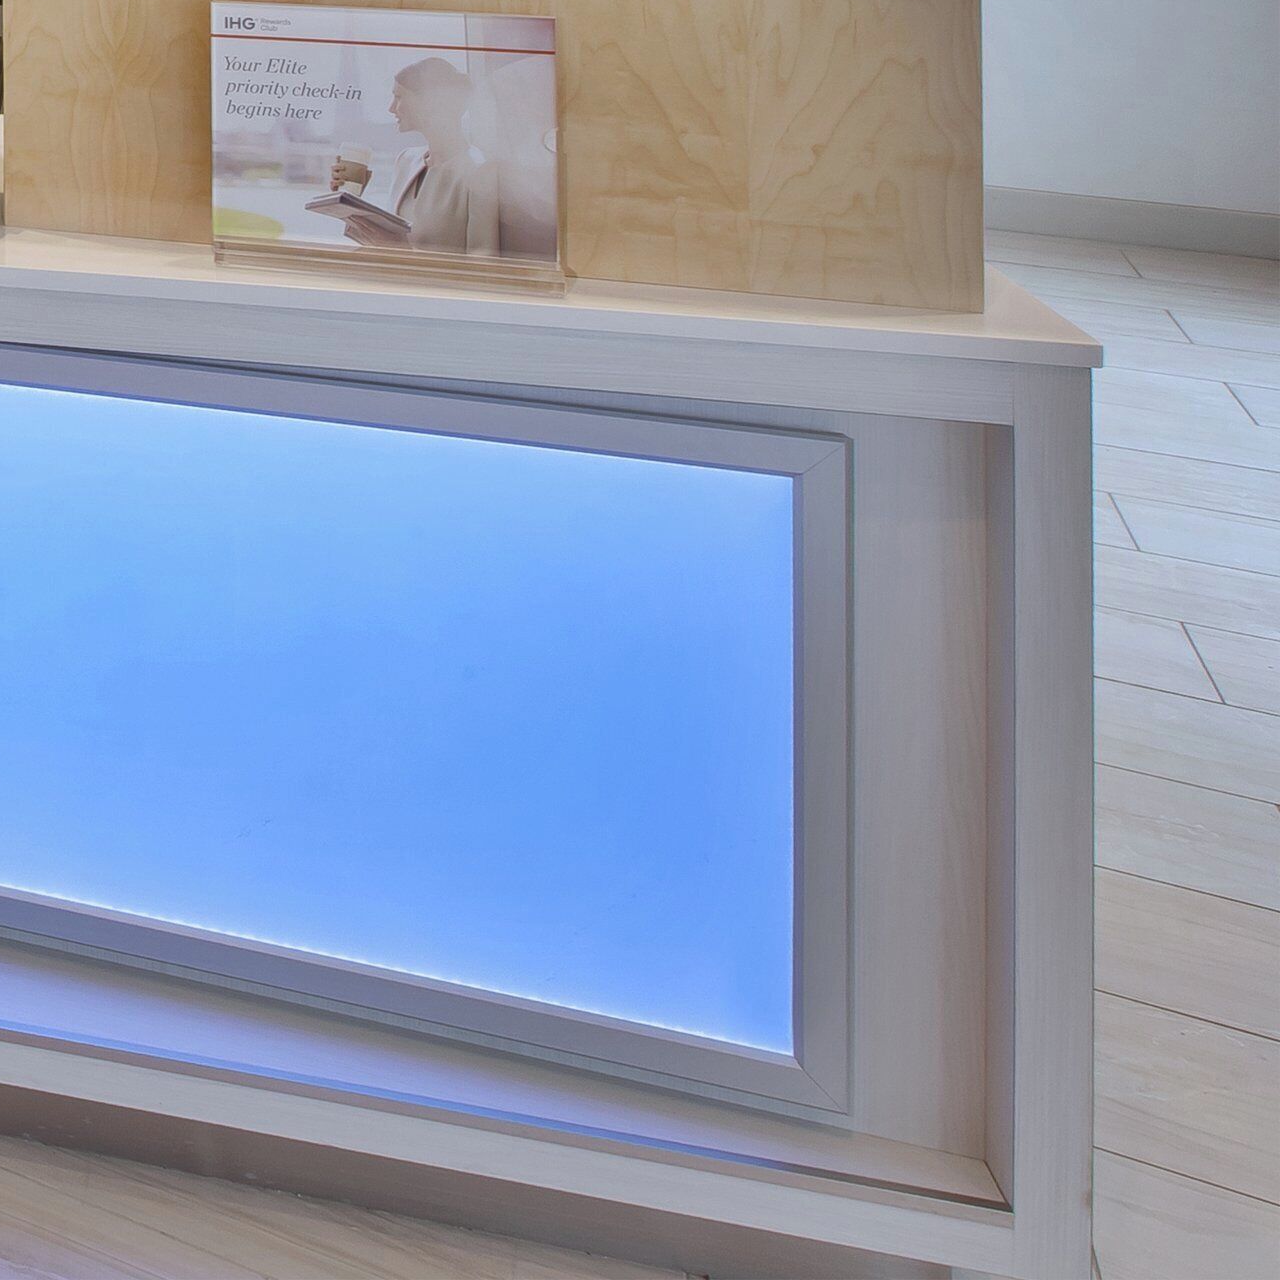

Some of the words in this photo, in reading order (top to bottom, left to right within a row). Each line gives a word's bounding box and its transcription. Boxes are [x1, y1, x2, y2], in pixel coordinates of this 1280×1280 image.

[224, 17, 256, 30] IHG
[260, 18, 291, 26] Rewards
[260, 24, 278, 32] Club
[224, 56, 262, 72] Your
[265, 58, 308, 75] Elite
[225, 80, 289, 99] priority
[292, 82, 362, 101] check-in
[226, 99, 281, 120] begins
[284, 103, 323, 120] here
